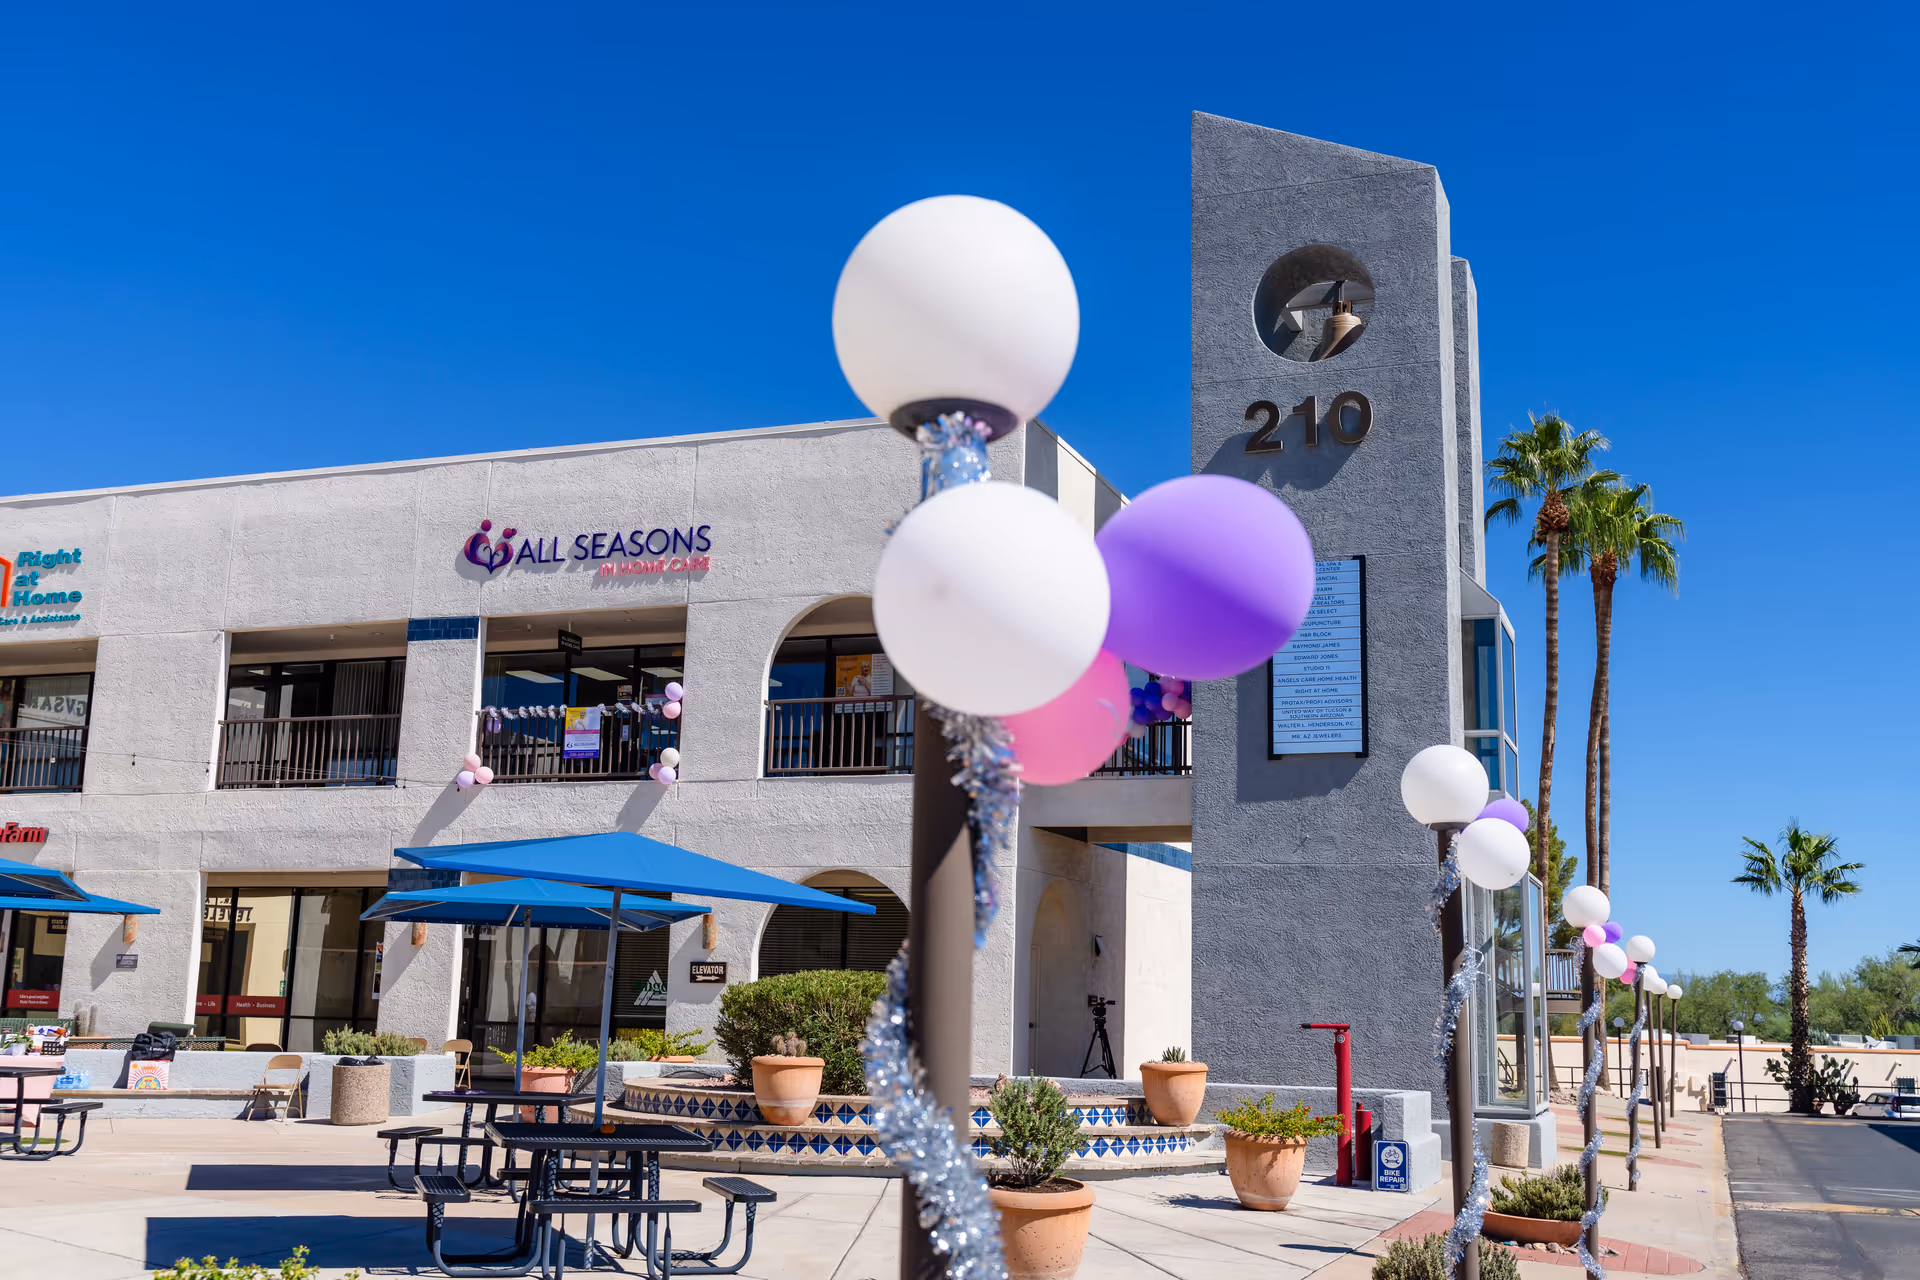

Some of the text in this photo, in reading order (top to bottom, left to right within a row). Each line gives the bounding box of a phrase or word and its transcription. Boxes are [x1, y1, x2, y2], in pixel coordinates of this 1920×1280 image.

[1244, 391, 1374, 454] 210
[515, 525, 711, 564] ALL SEASONS
[17, 548, 83, 569] Right
[600, 556, 712, 577] IN HOME CARE
[14, 570, 40, 586] at
[13, 590, 83, 606] Home
[0, 613, 81, 626] Care & Assistance
[692, 965, 724, 975] ELEVATOR
[1380, 1175, 1405, 1183] REPAIR
